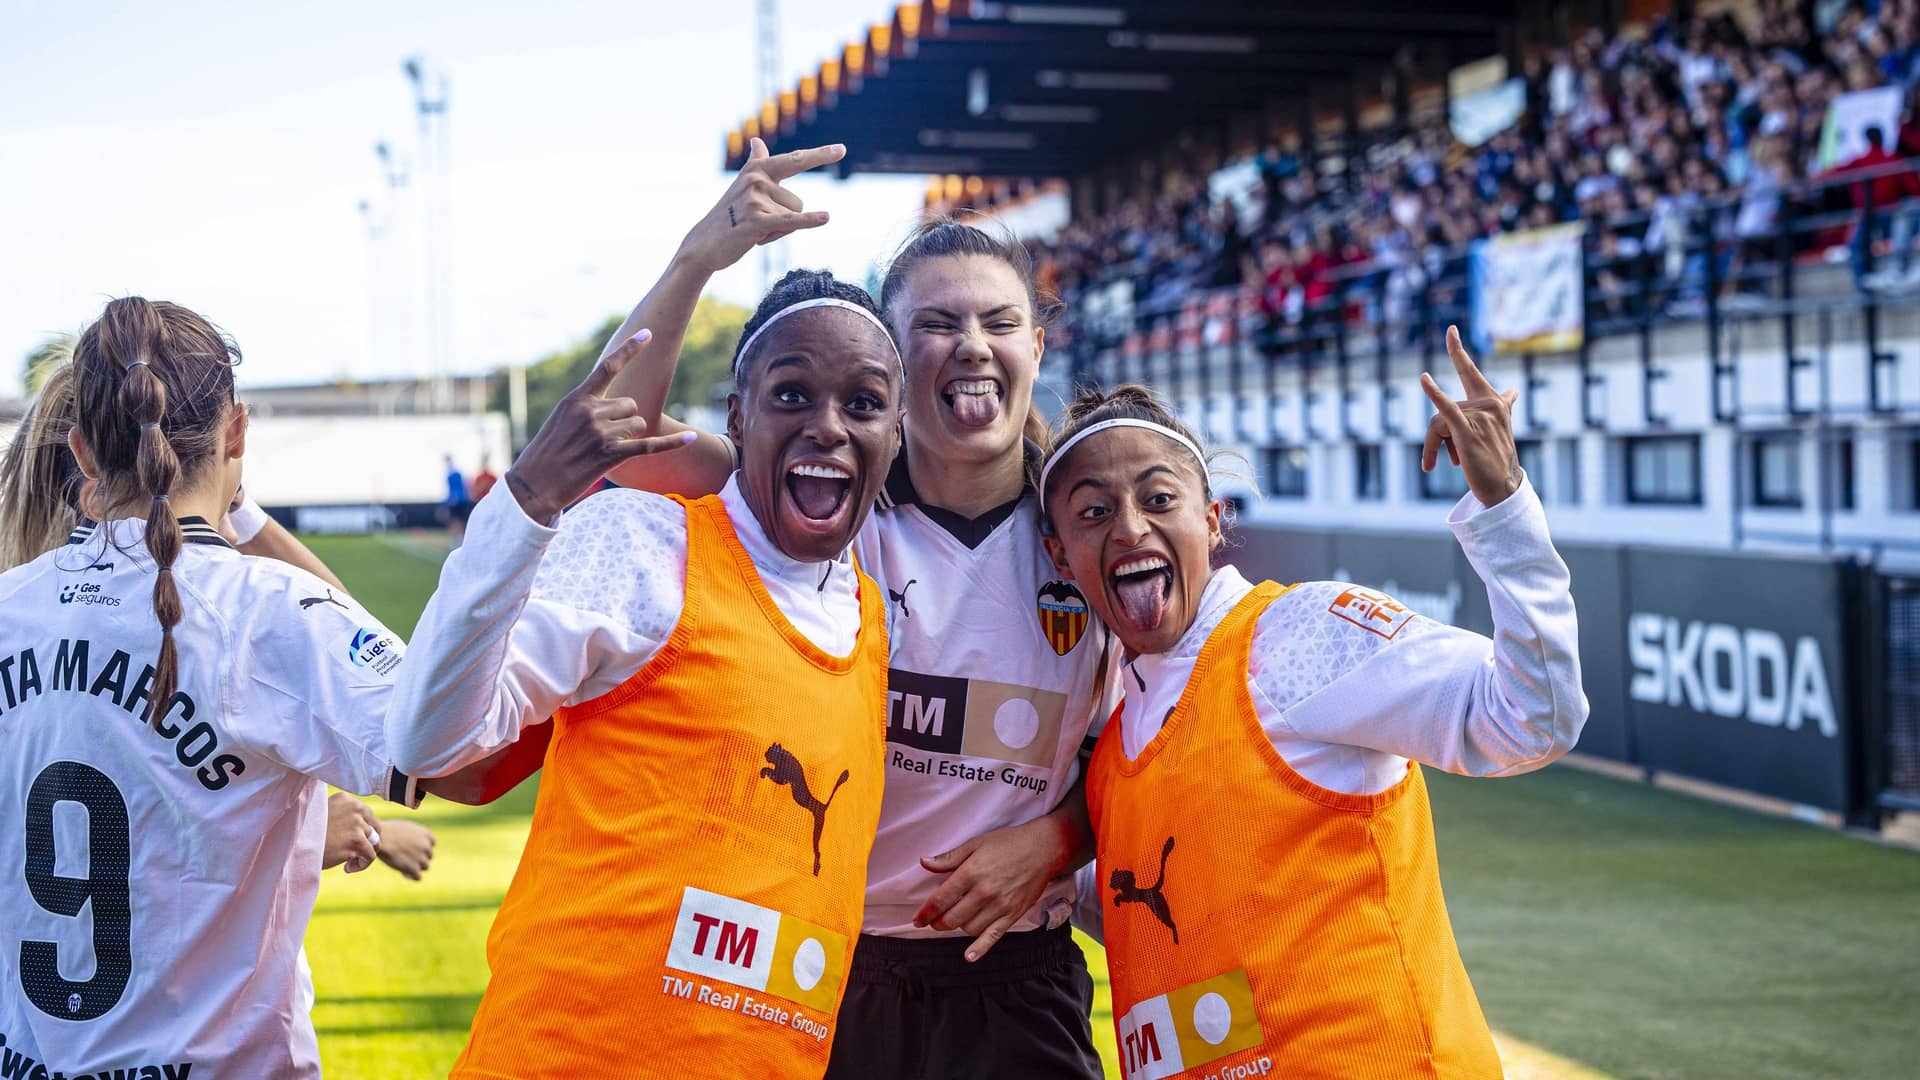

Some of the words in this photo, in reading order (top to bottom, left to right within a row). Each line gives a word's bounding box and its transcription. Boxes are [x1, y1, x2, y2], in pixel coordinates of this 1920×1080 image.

[75, 594, 121, 606] seguros
[81, 583, 101, 592] Ges
[0, 647, 42, 716] TA
[1628, 612, 1838, 738] SKODA
[892, 751, 932, 775] Real
[939, 760, 995, 782] Estate
[1001, 767, 1048, 795] Group
[19, 760, 132, 1021] 9
[692, 912, 759, 969] TM
[662, 975, 694, 999] TM
[697, 985, 739, 1012] Real
[742, 997, 788, 1025] Estate
[791, 1012, 828, 1042] Group
